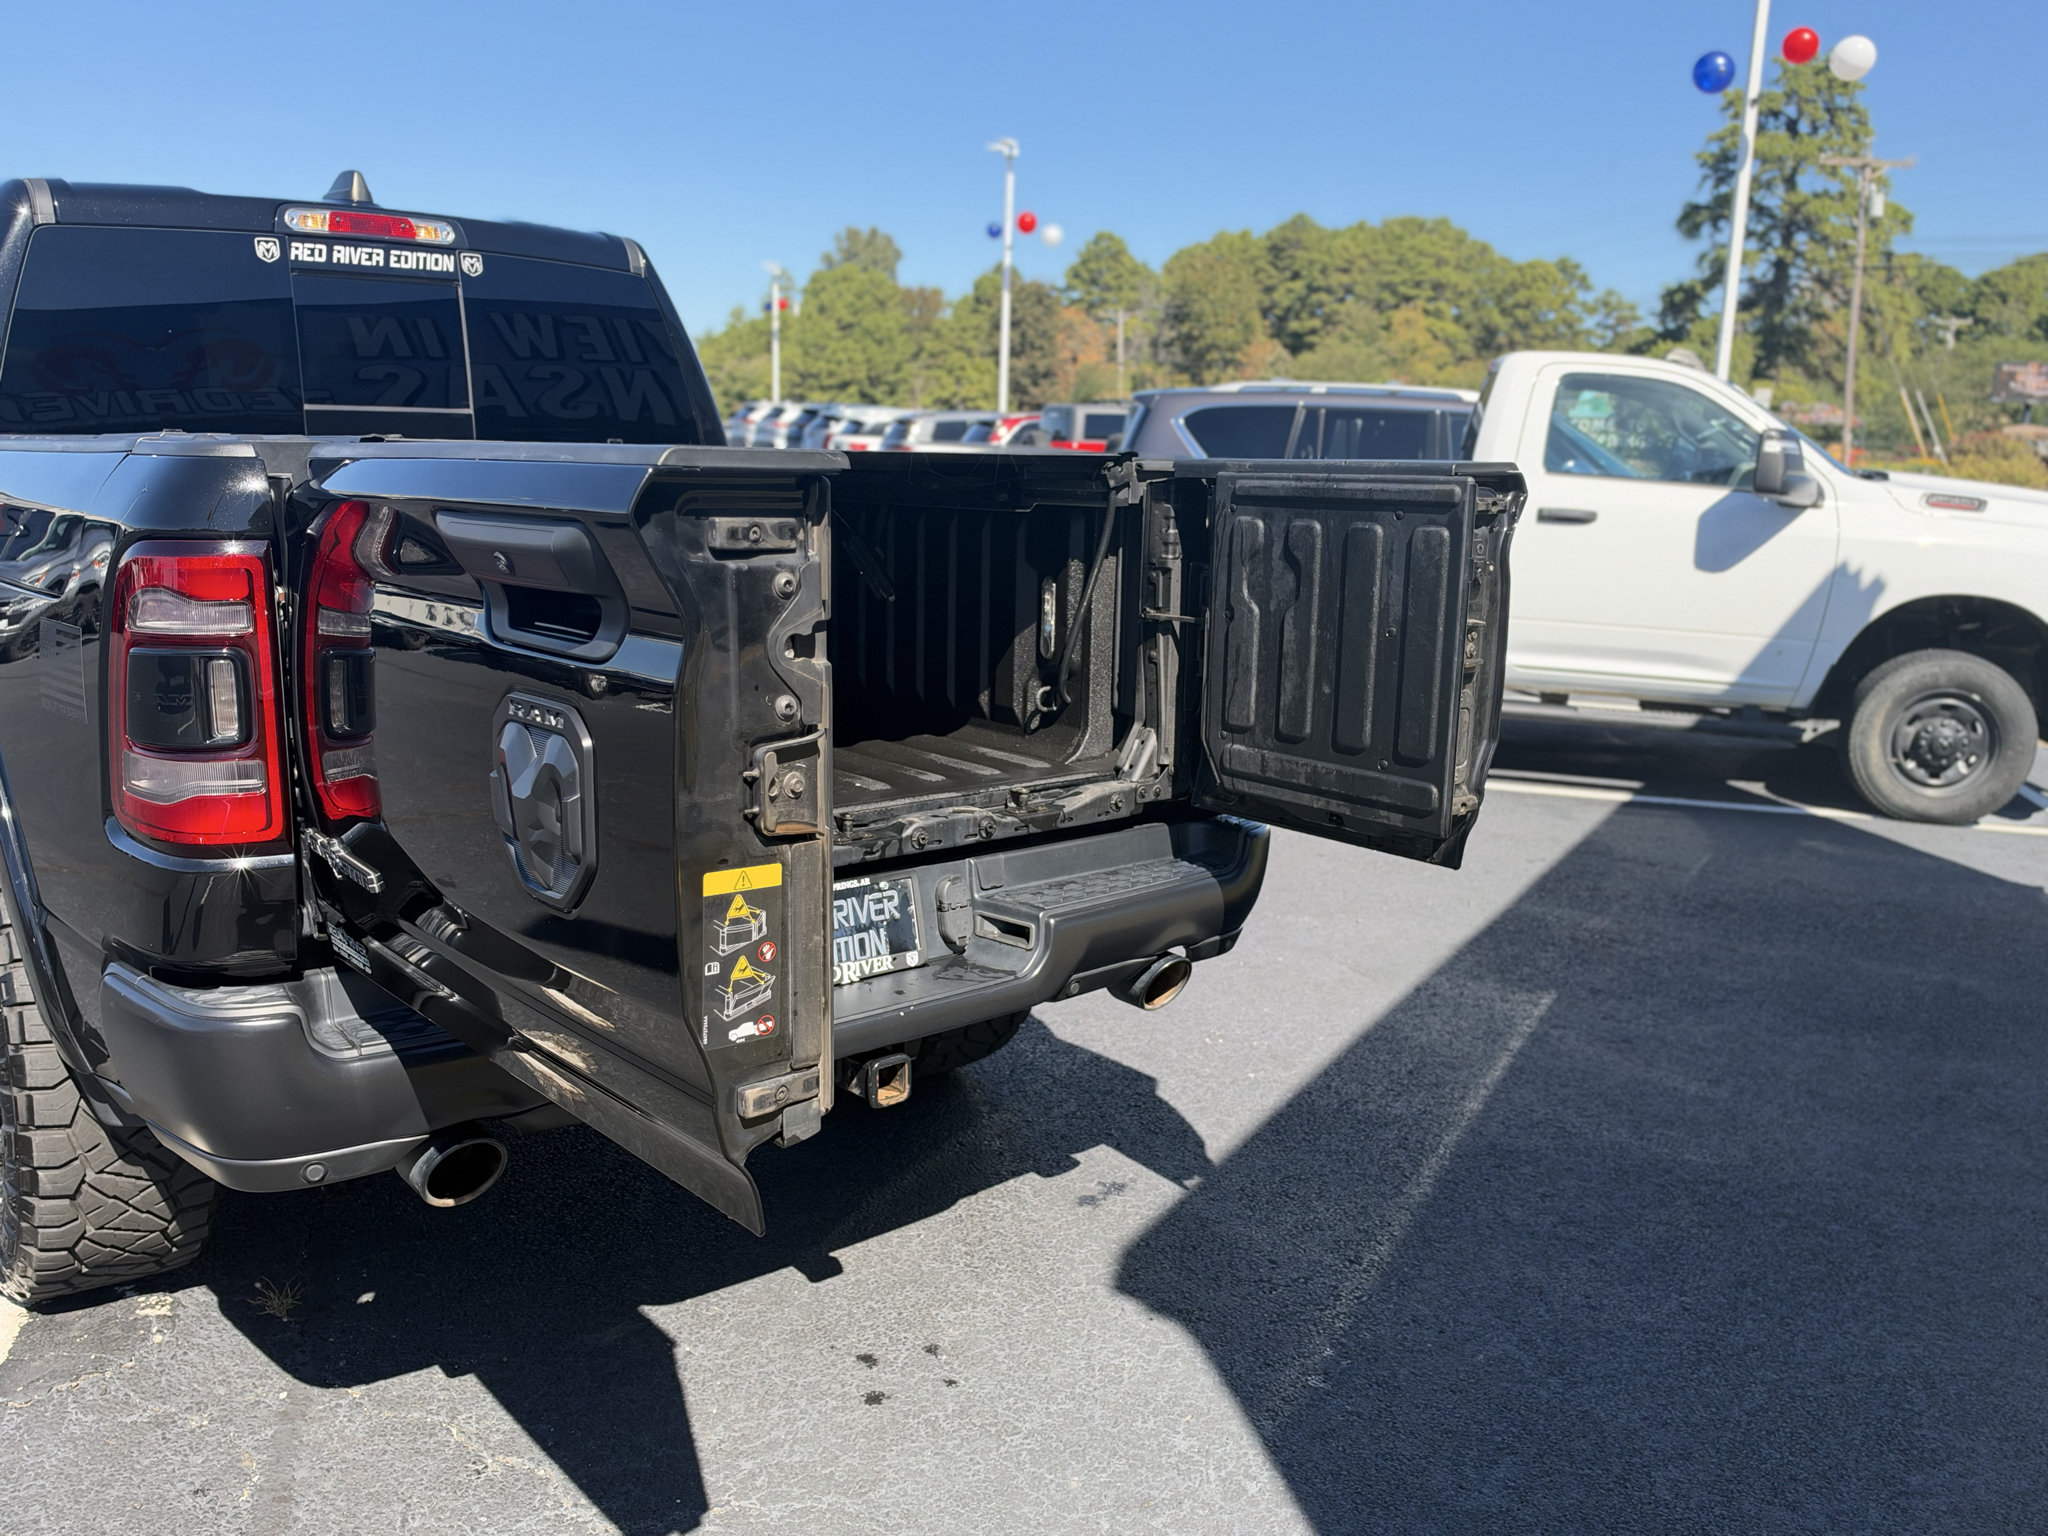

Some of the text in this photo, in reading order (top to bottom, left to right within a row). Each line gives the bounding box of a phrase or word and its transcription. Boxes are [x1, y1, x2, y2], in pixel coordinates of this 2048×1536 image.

[291, 242, 455, 272] RED RIVER EDITION
[508, 701, 564, 729] RAM
[833, 889, 901, 930] RIVER
